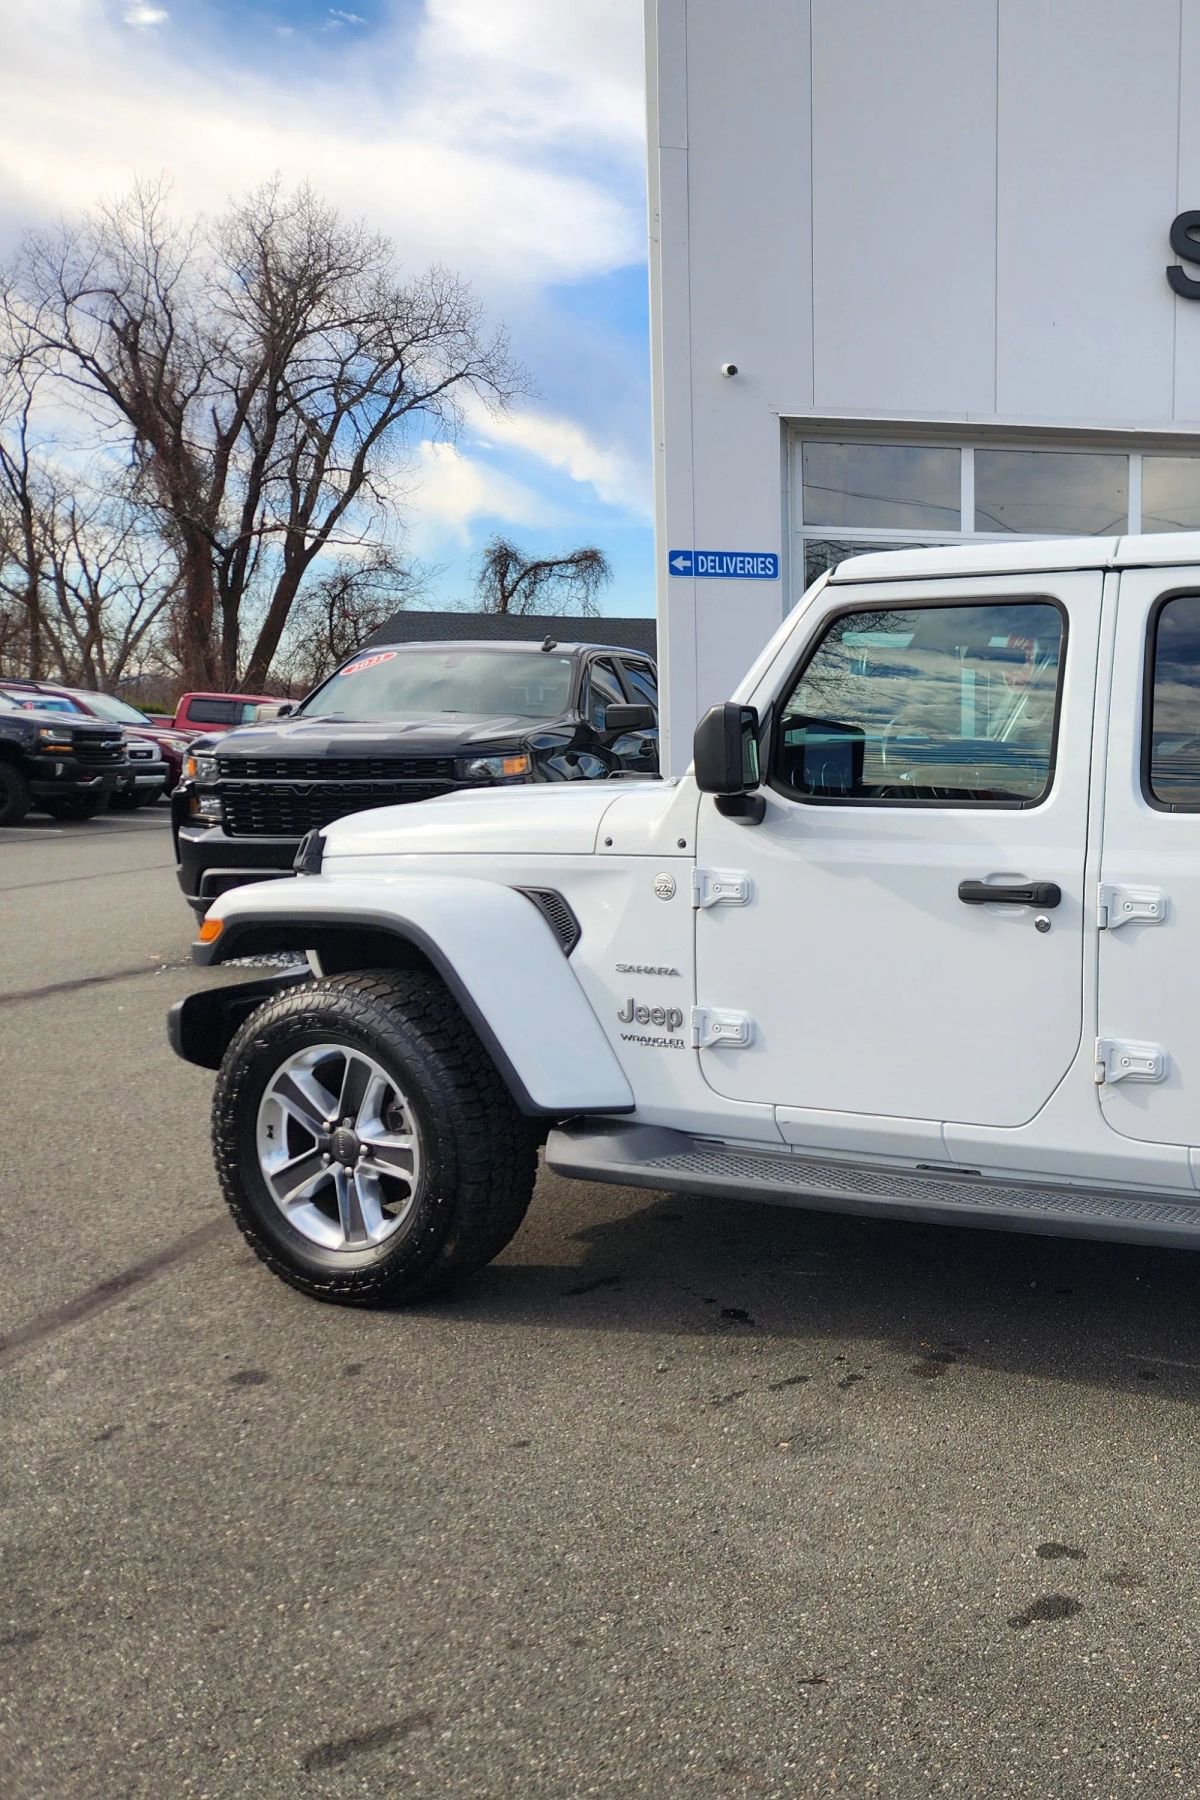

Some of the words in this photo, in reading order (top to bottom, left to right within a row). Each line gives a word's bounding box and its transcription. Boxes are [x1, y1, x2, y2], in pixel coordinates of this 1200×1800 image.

[698, 555, 774, 575] DELIVERIES
[615, 963, 683, 977] SAHARA
[617, 997, 683, 1032] Jeep
[620, 1033, 684, 1046] WRANGLER
